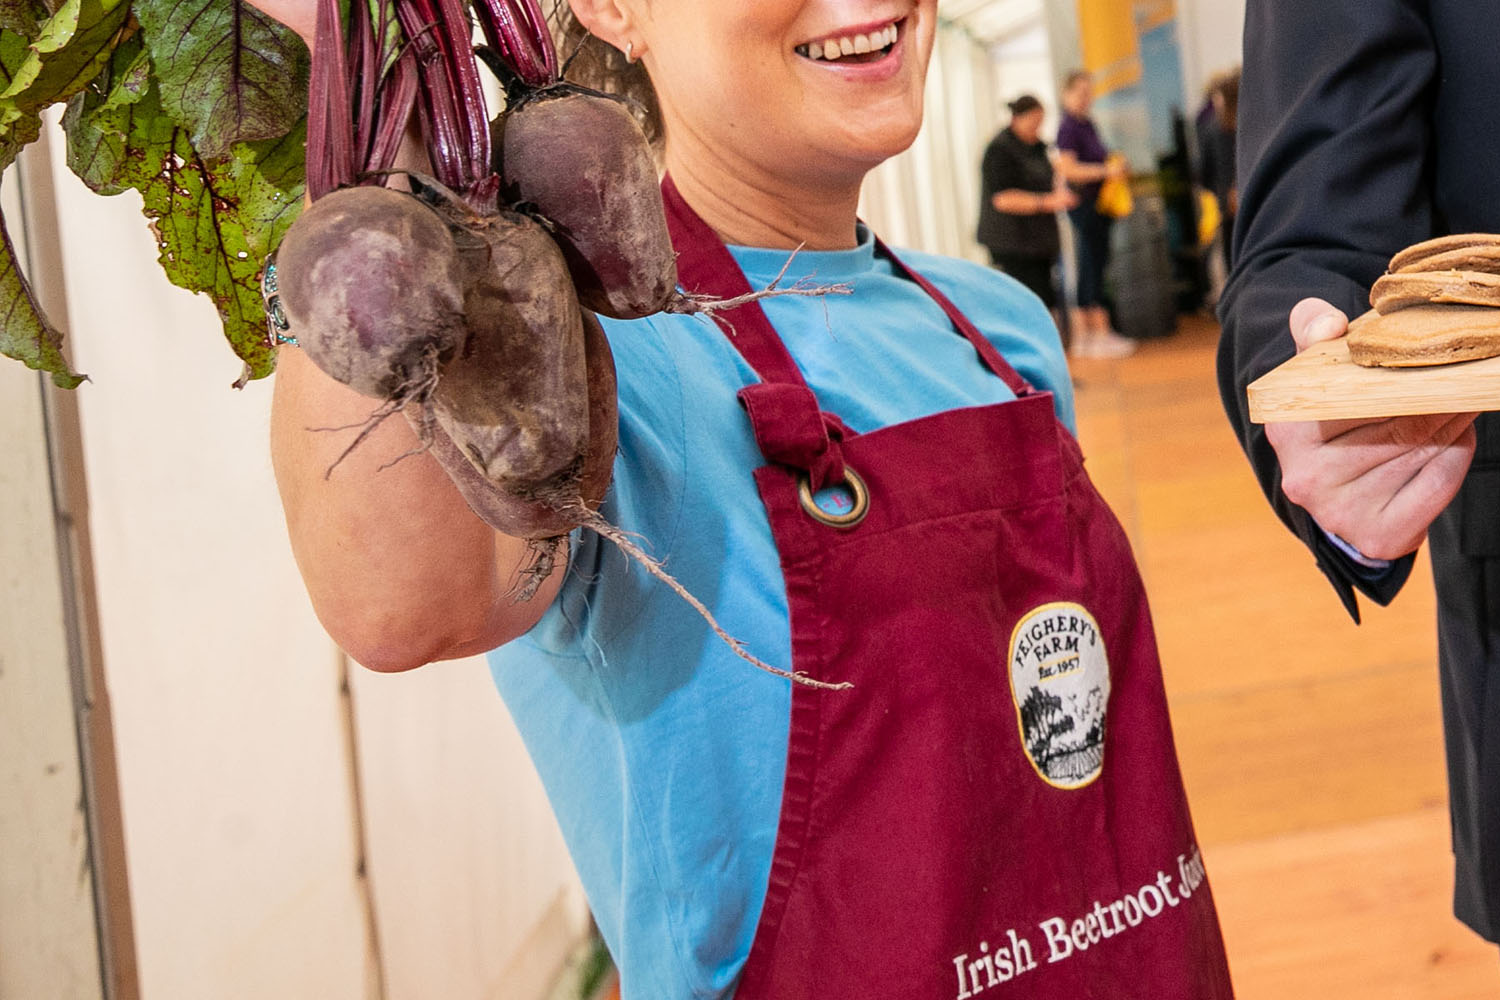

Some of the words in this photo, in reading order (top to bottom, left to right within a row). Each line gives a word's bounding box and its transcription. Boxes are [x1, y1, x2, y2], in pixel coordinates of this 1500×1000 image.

[1033, 635, 1080, 662] FARM
[1057, 656, 1080, 674] 1957
[953, 940, 1038, 1000] Irish
[1039, 870, 1180, 964] Beetroot
